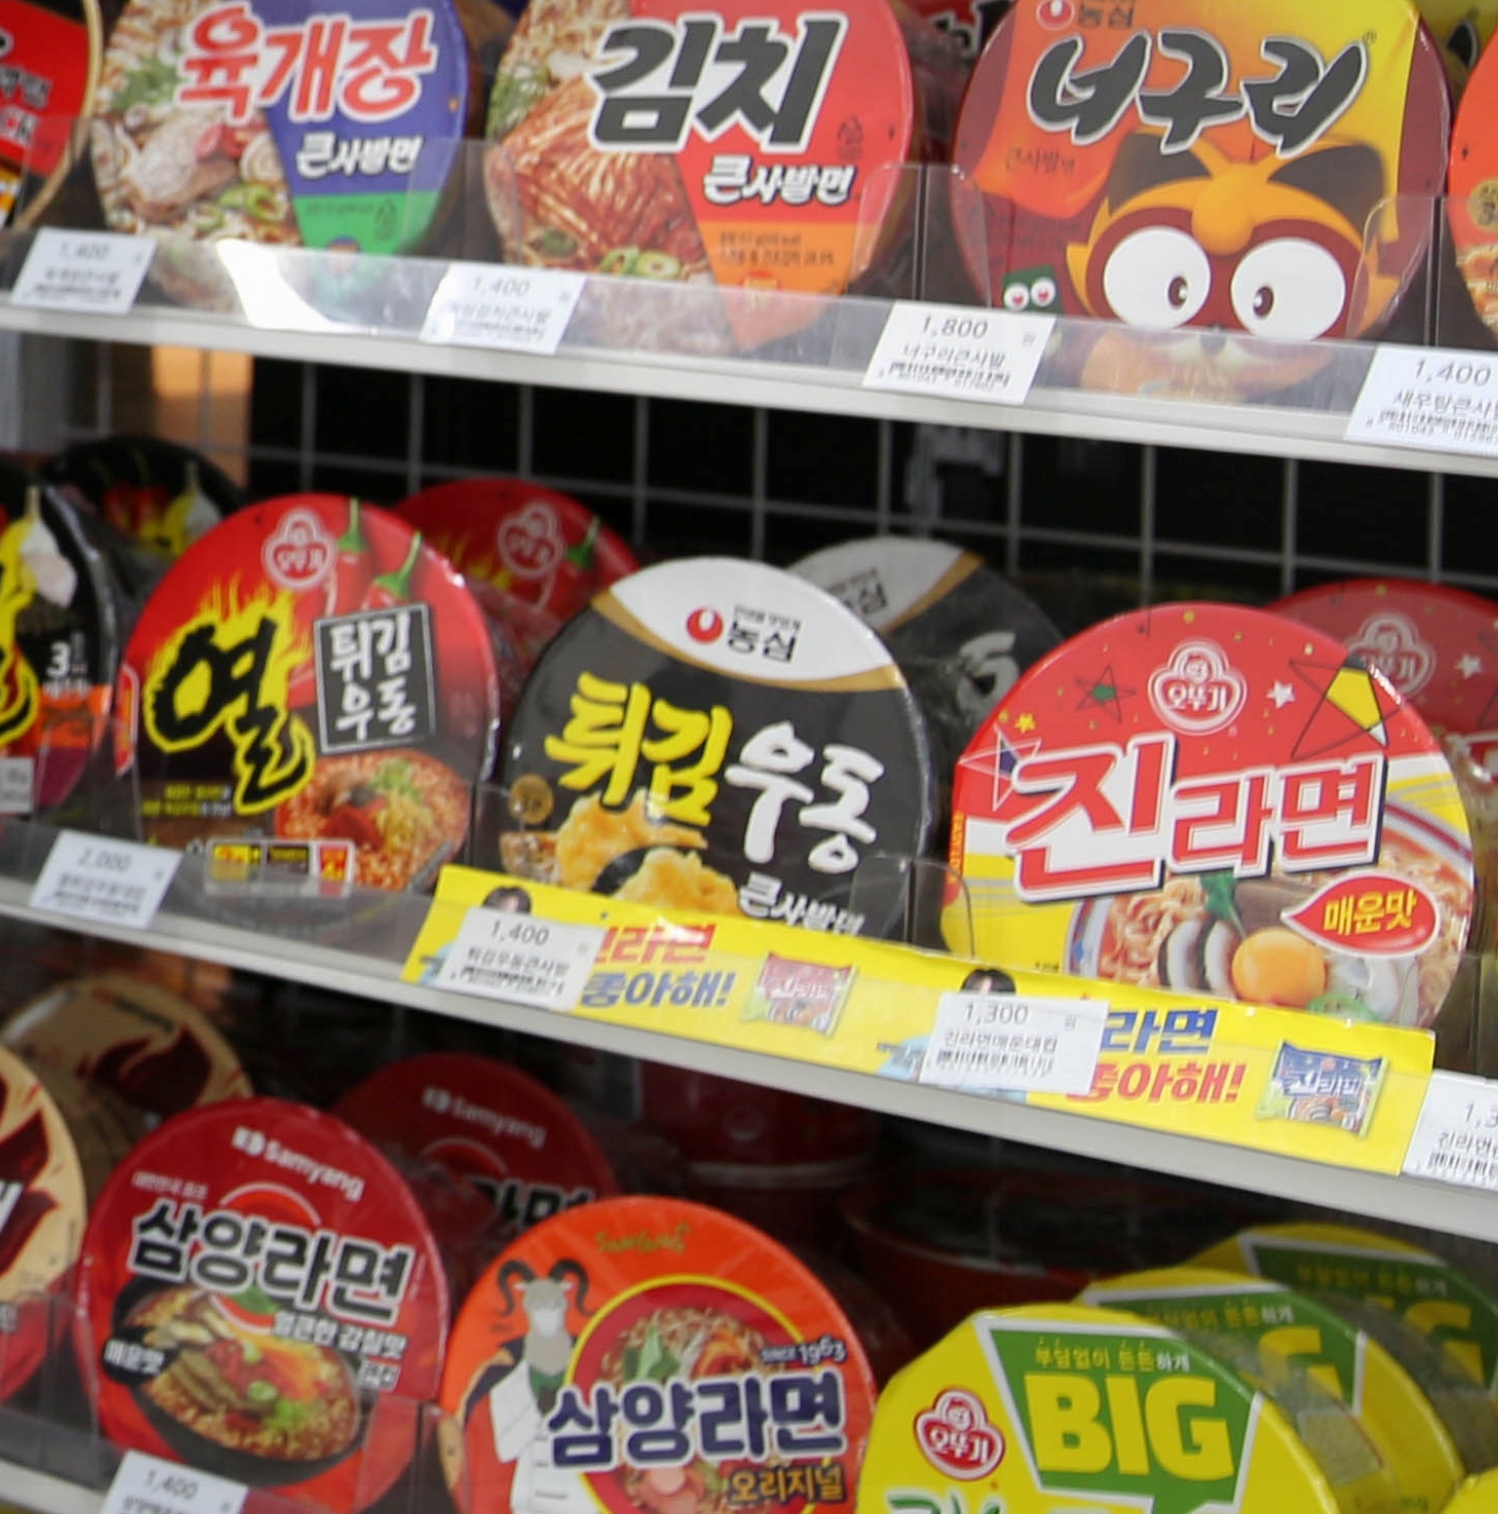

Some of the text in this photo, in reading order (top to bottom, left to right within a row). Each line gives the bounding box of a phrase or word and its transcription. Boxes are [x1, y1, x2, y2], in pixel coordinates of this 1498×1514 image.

[175, 0, 435, 124] 육개장
[587, 13, 847, 154] 김치
[1026, 29, 1368, 158] 너구리
[704, 156, 856, 205] 큰사발면
[922, 316, 989, 339] 1,800
[1415, 359, 1492, 385] 1,400
[727, 619, 797, 663] 농심
[1166, 683, 1230, 711] 오뚜기
[1006, 732, 1386, 900] 진라면
[491, 919, 550, 945] 1,400
[1323, 889, 1417, 935] 매운맛
[964, 1002, 1030, 1025] 1,300
[128, 1197, 415, 1327] 삼양라면
[546, 1367, 848, 1471] 삼양라면
[1023, 1372, 1235, 1481] BIG
[930, 1426, 990, 1466] 오뚜기
[727, 1464, 847, 1506] 오리지널
